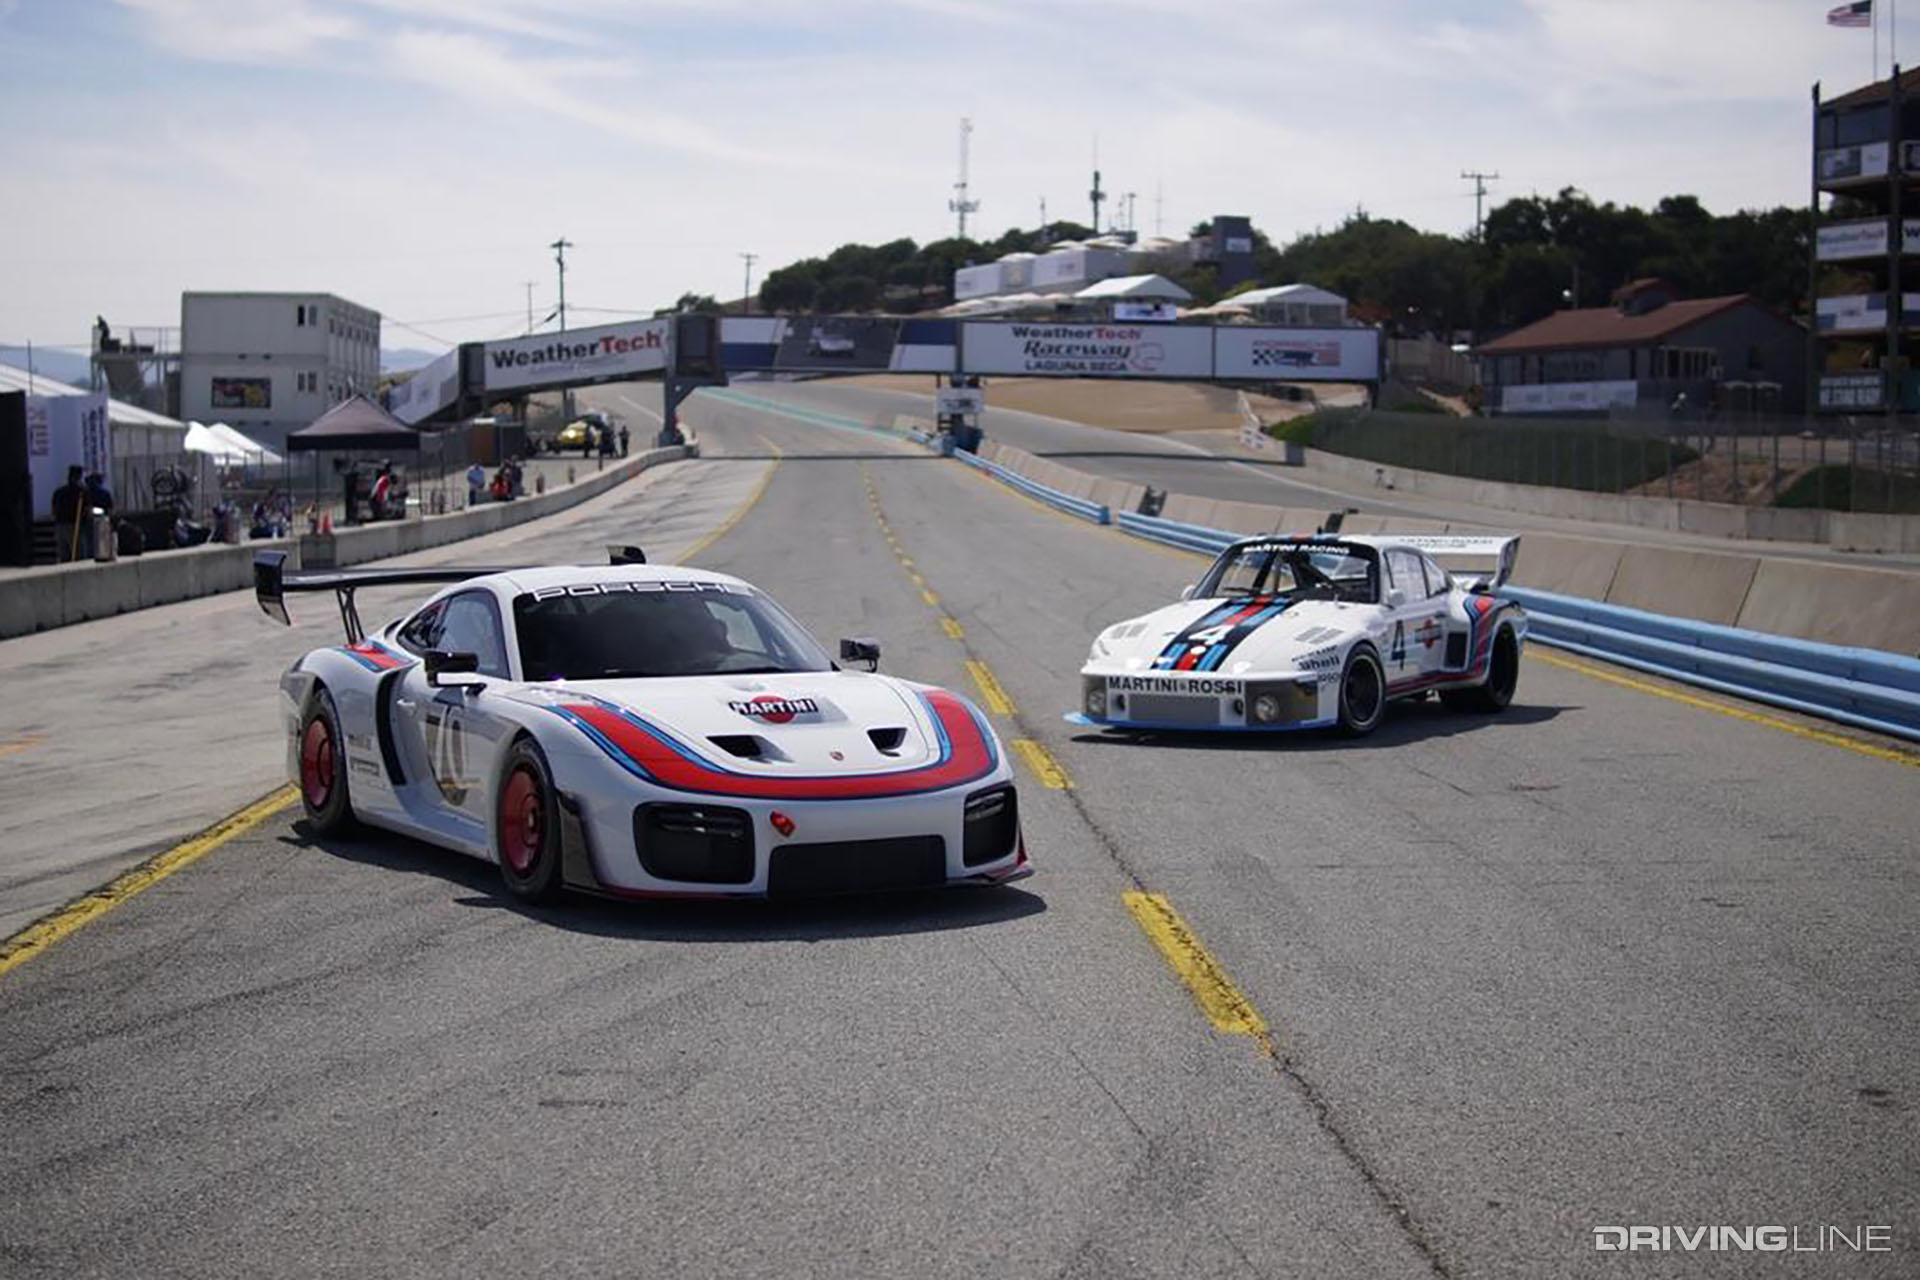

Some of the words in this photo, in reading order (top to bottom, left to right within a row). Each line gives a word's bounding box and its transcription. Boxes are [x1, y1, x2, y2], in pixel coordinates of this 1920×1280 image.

[1011, 326, 1141, 340] WeatherTech
[492, 328, 662, 369] WeatherTech
[1023, 339, 1131, 358] Raceway
[1025, 359, 1086, 371] LAGUNA
[1391, 620, 1406, 670] 4
[1109, 677, 1178, 692] MARTINI
[1188, 680, 1242, 693] ROSSI
[728, 698, 819, 716] MARTINI
